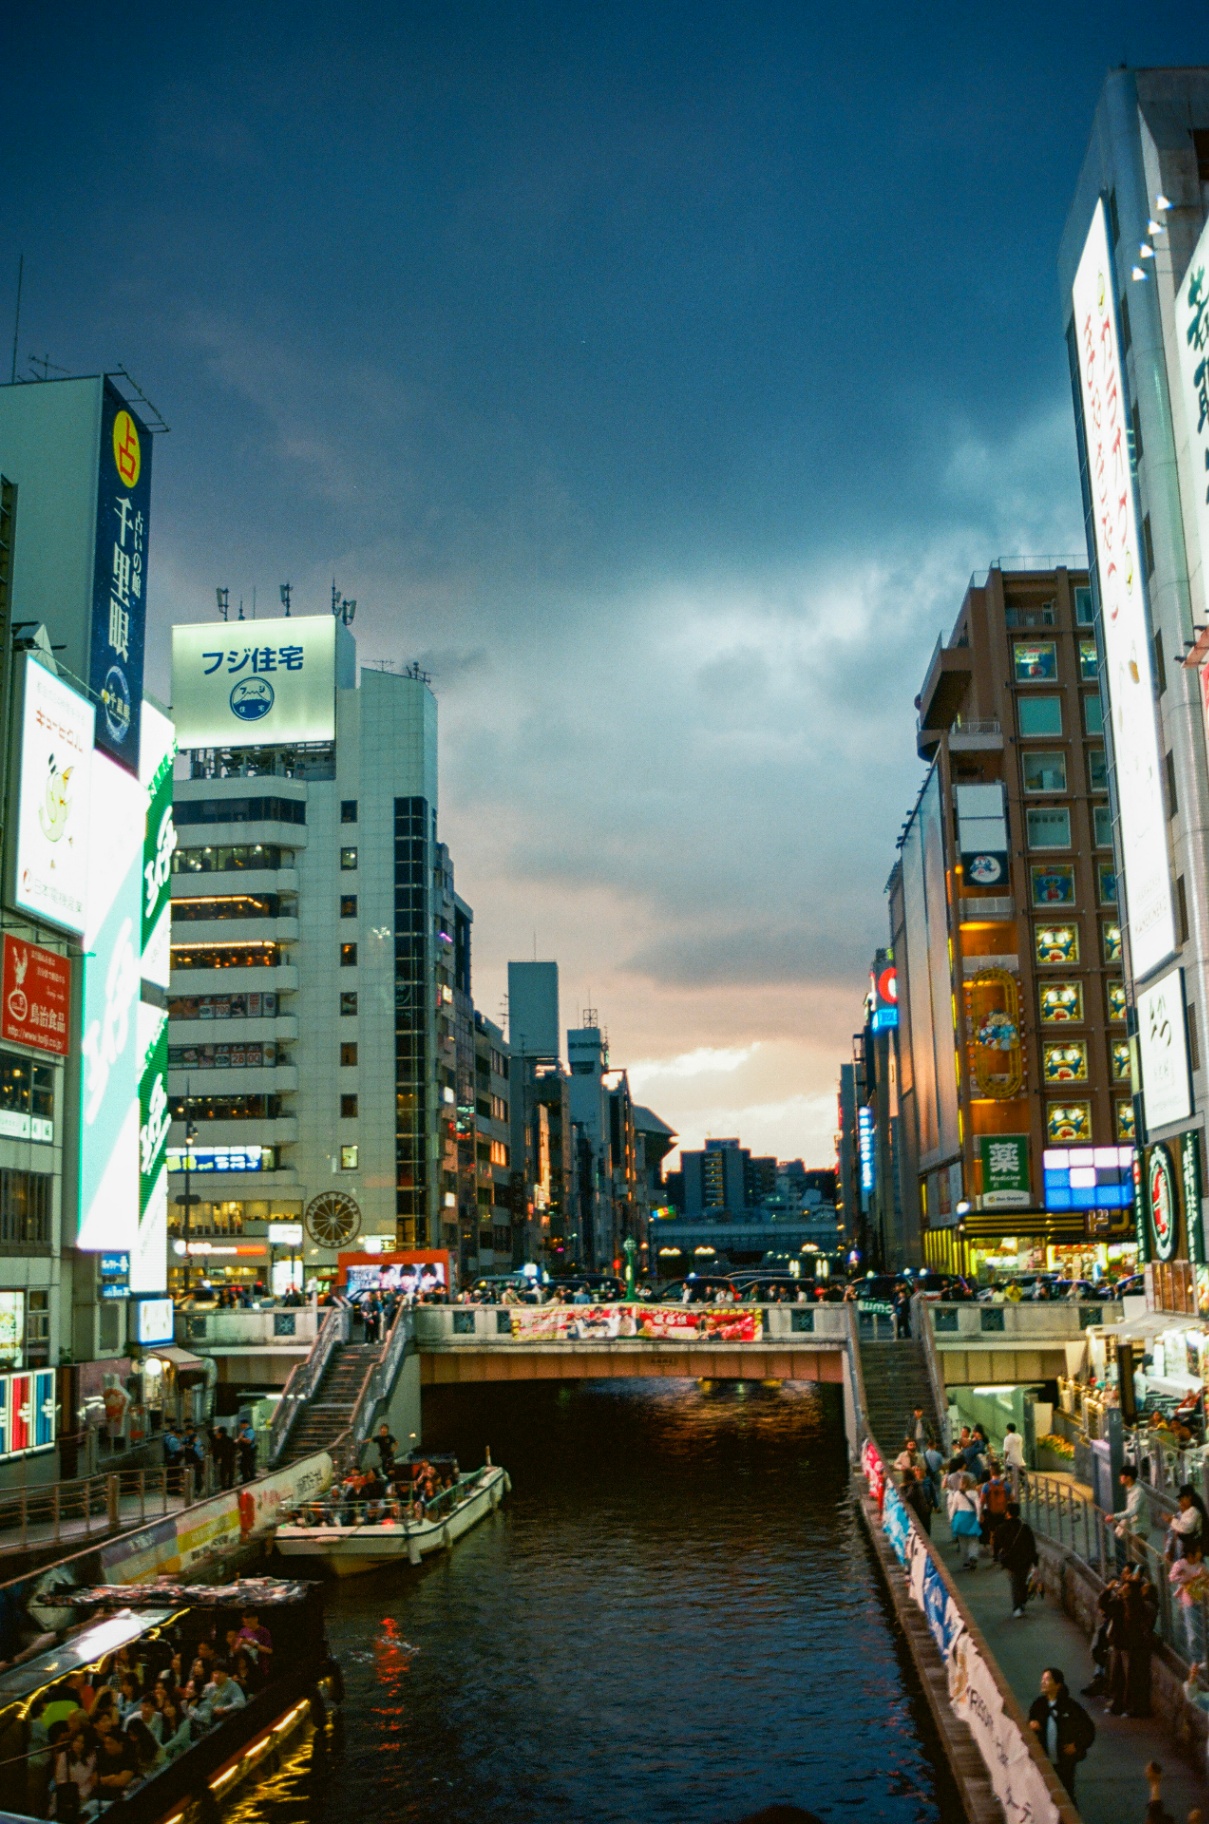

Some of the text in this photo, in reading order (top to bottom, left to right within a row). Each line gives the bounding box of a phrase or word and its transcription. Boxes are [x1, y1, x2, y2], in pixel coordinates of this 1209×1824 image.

[118, 416, 138, 482] 占
[108, 496, 134, 664] 千里眼
[202, 645, 304, 675] フジ住宅
[989, 1142, 1020, 1173] 薬
